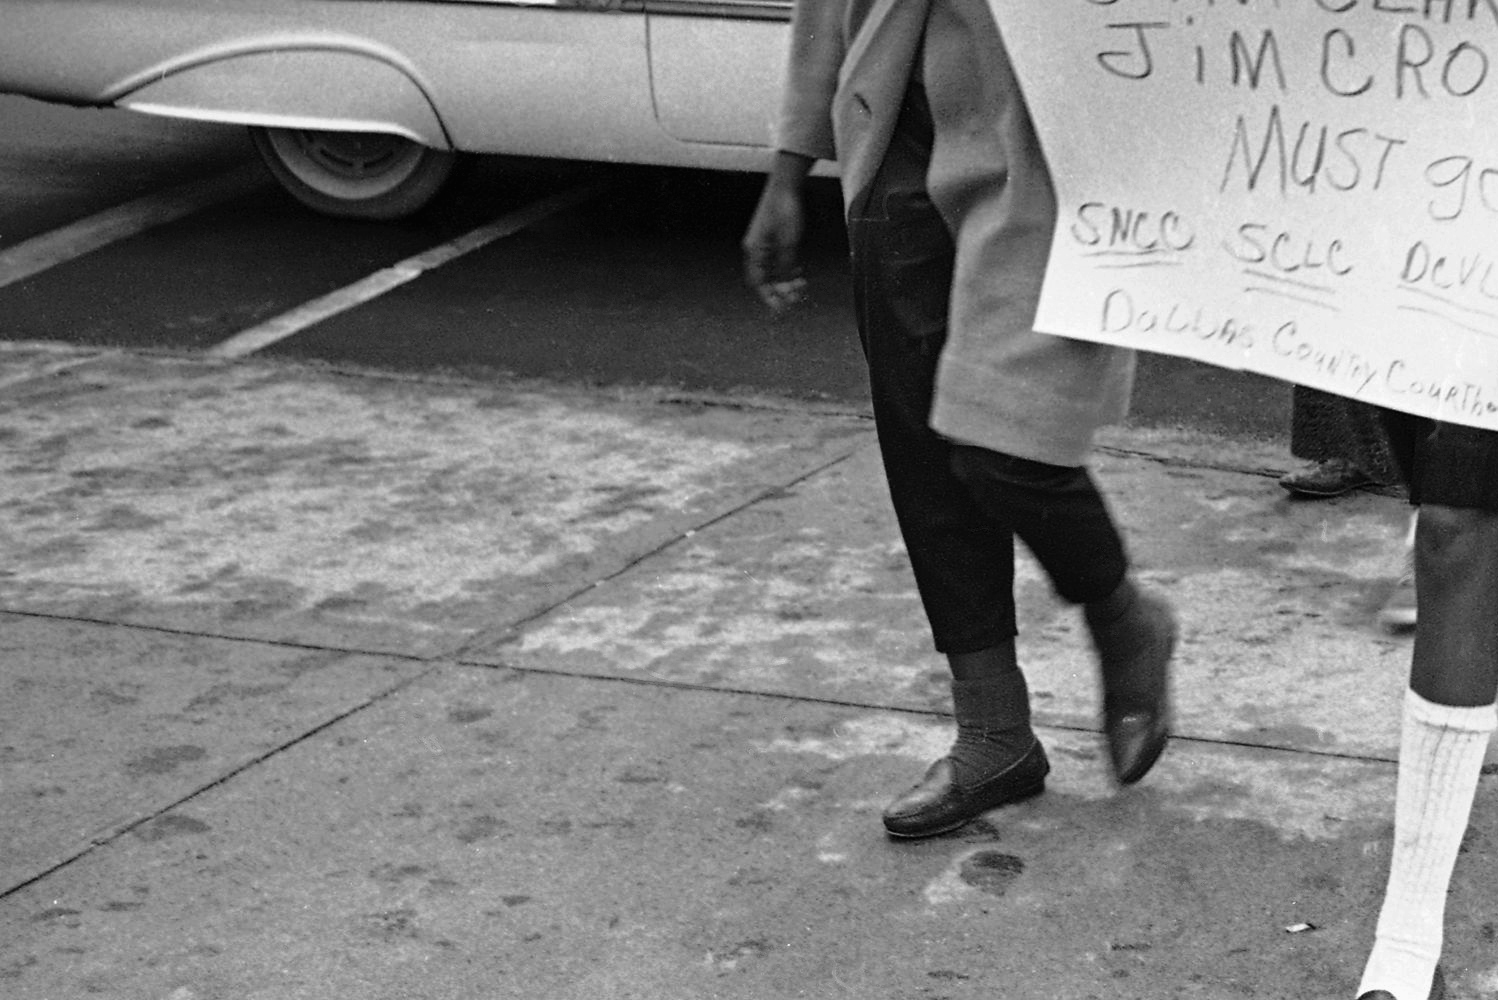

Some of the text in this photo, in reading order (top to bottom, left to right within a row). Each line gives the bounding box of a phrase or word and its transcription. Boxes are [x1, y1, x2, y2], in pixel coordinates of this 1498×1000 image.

[1218, 103, 1408, 197] MUST
[1070, 200, 1196, 252] SNCC
[1220, 221, 1355, 276] SCLC
